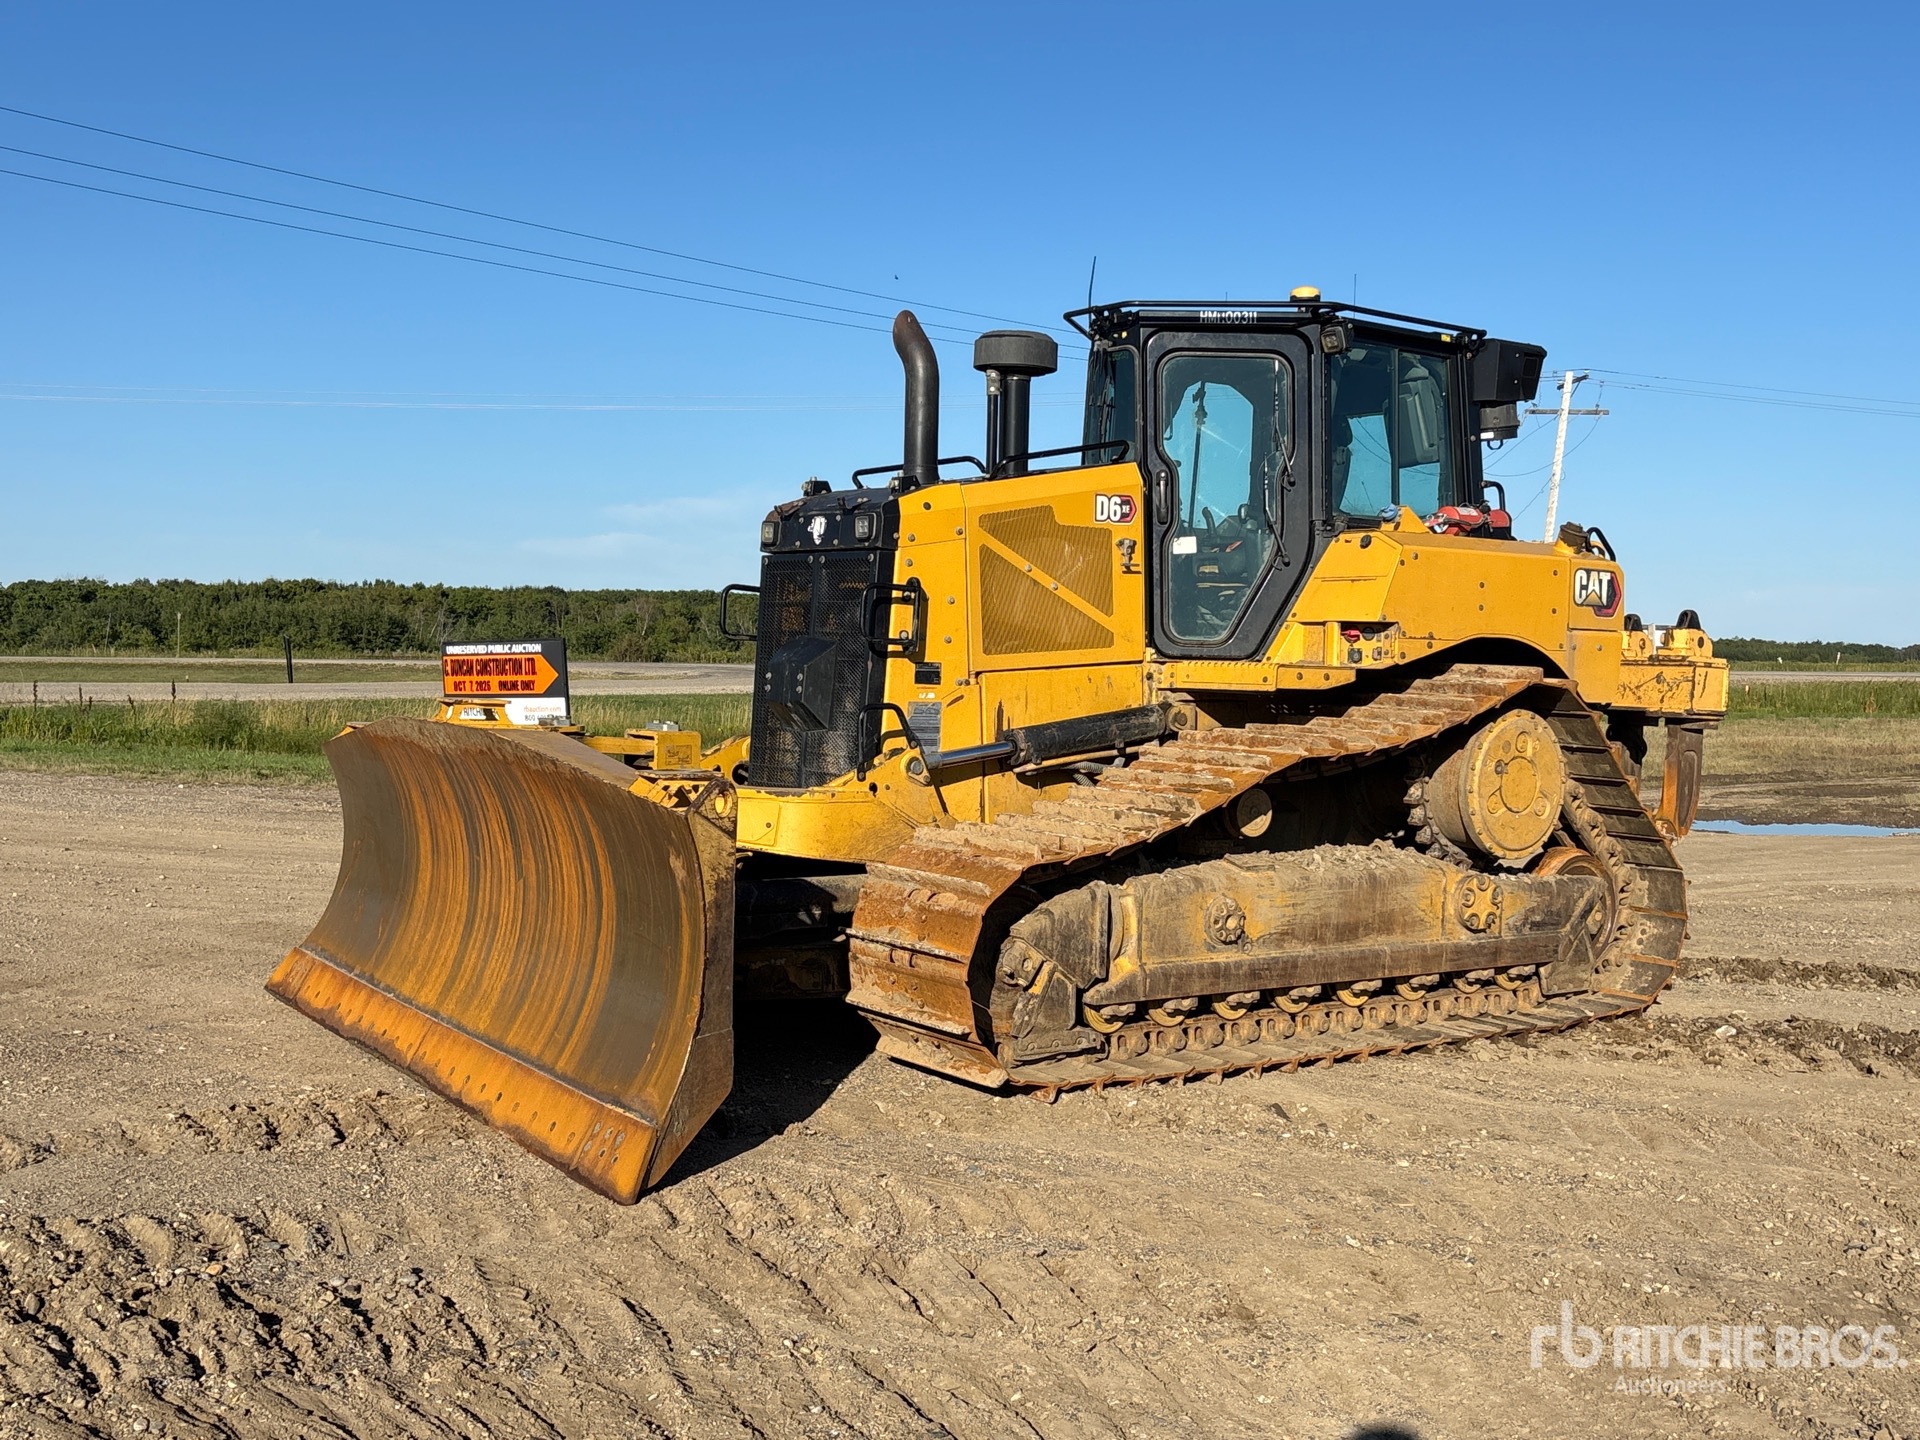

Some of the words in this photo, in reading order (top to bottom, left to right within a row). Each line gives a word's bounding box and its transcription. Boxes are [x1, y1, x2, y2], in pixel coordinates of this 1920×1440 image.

[1095, 494, 1122, 522] D6
[1121, 504, 1131, 514] XE
[1574, 569, 1612, 606] CAT
[446, 645, 487, 655] UNRESERVED
[487, 644, 511, 654] PUBLIC
[511, 643, 542, 653] AUCTION
[450, 658, 475, 677] DUNCAN
[475, 657, 523, 677] CONSTRUCTION
[524, 657, 538, 676] LTD.
[453, 680, 467, 692] OCT
[498, 680, 520, 692] ONLINE
[520, 679, 536, 692] ONLY
